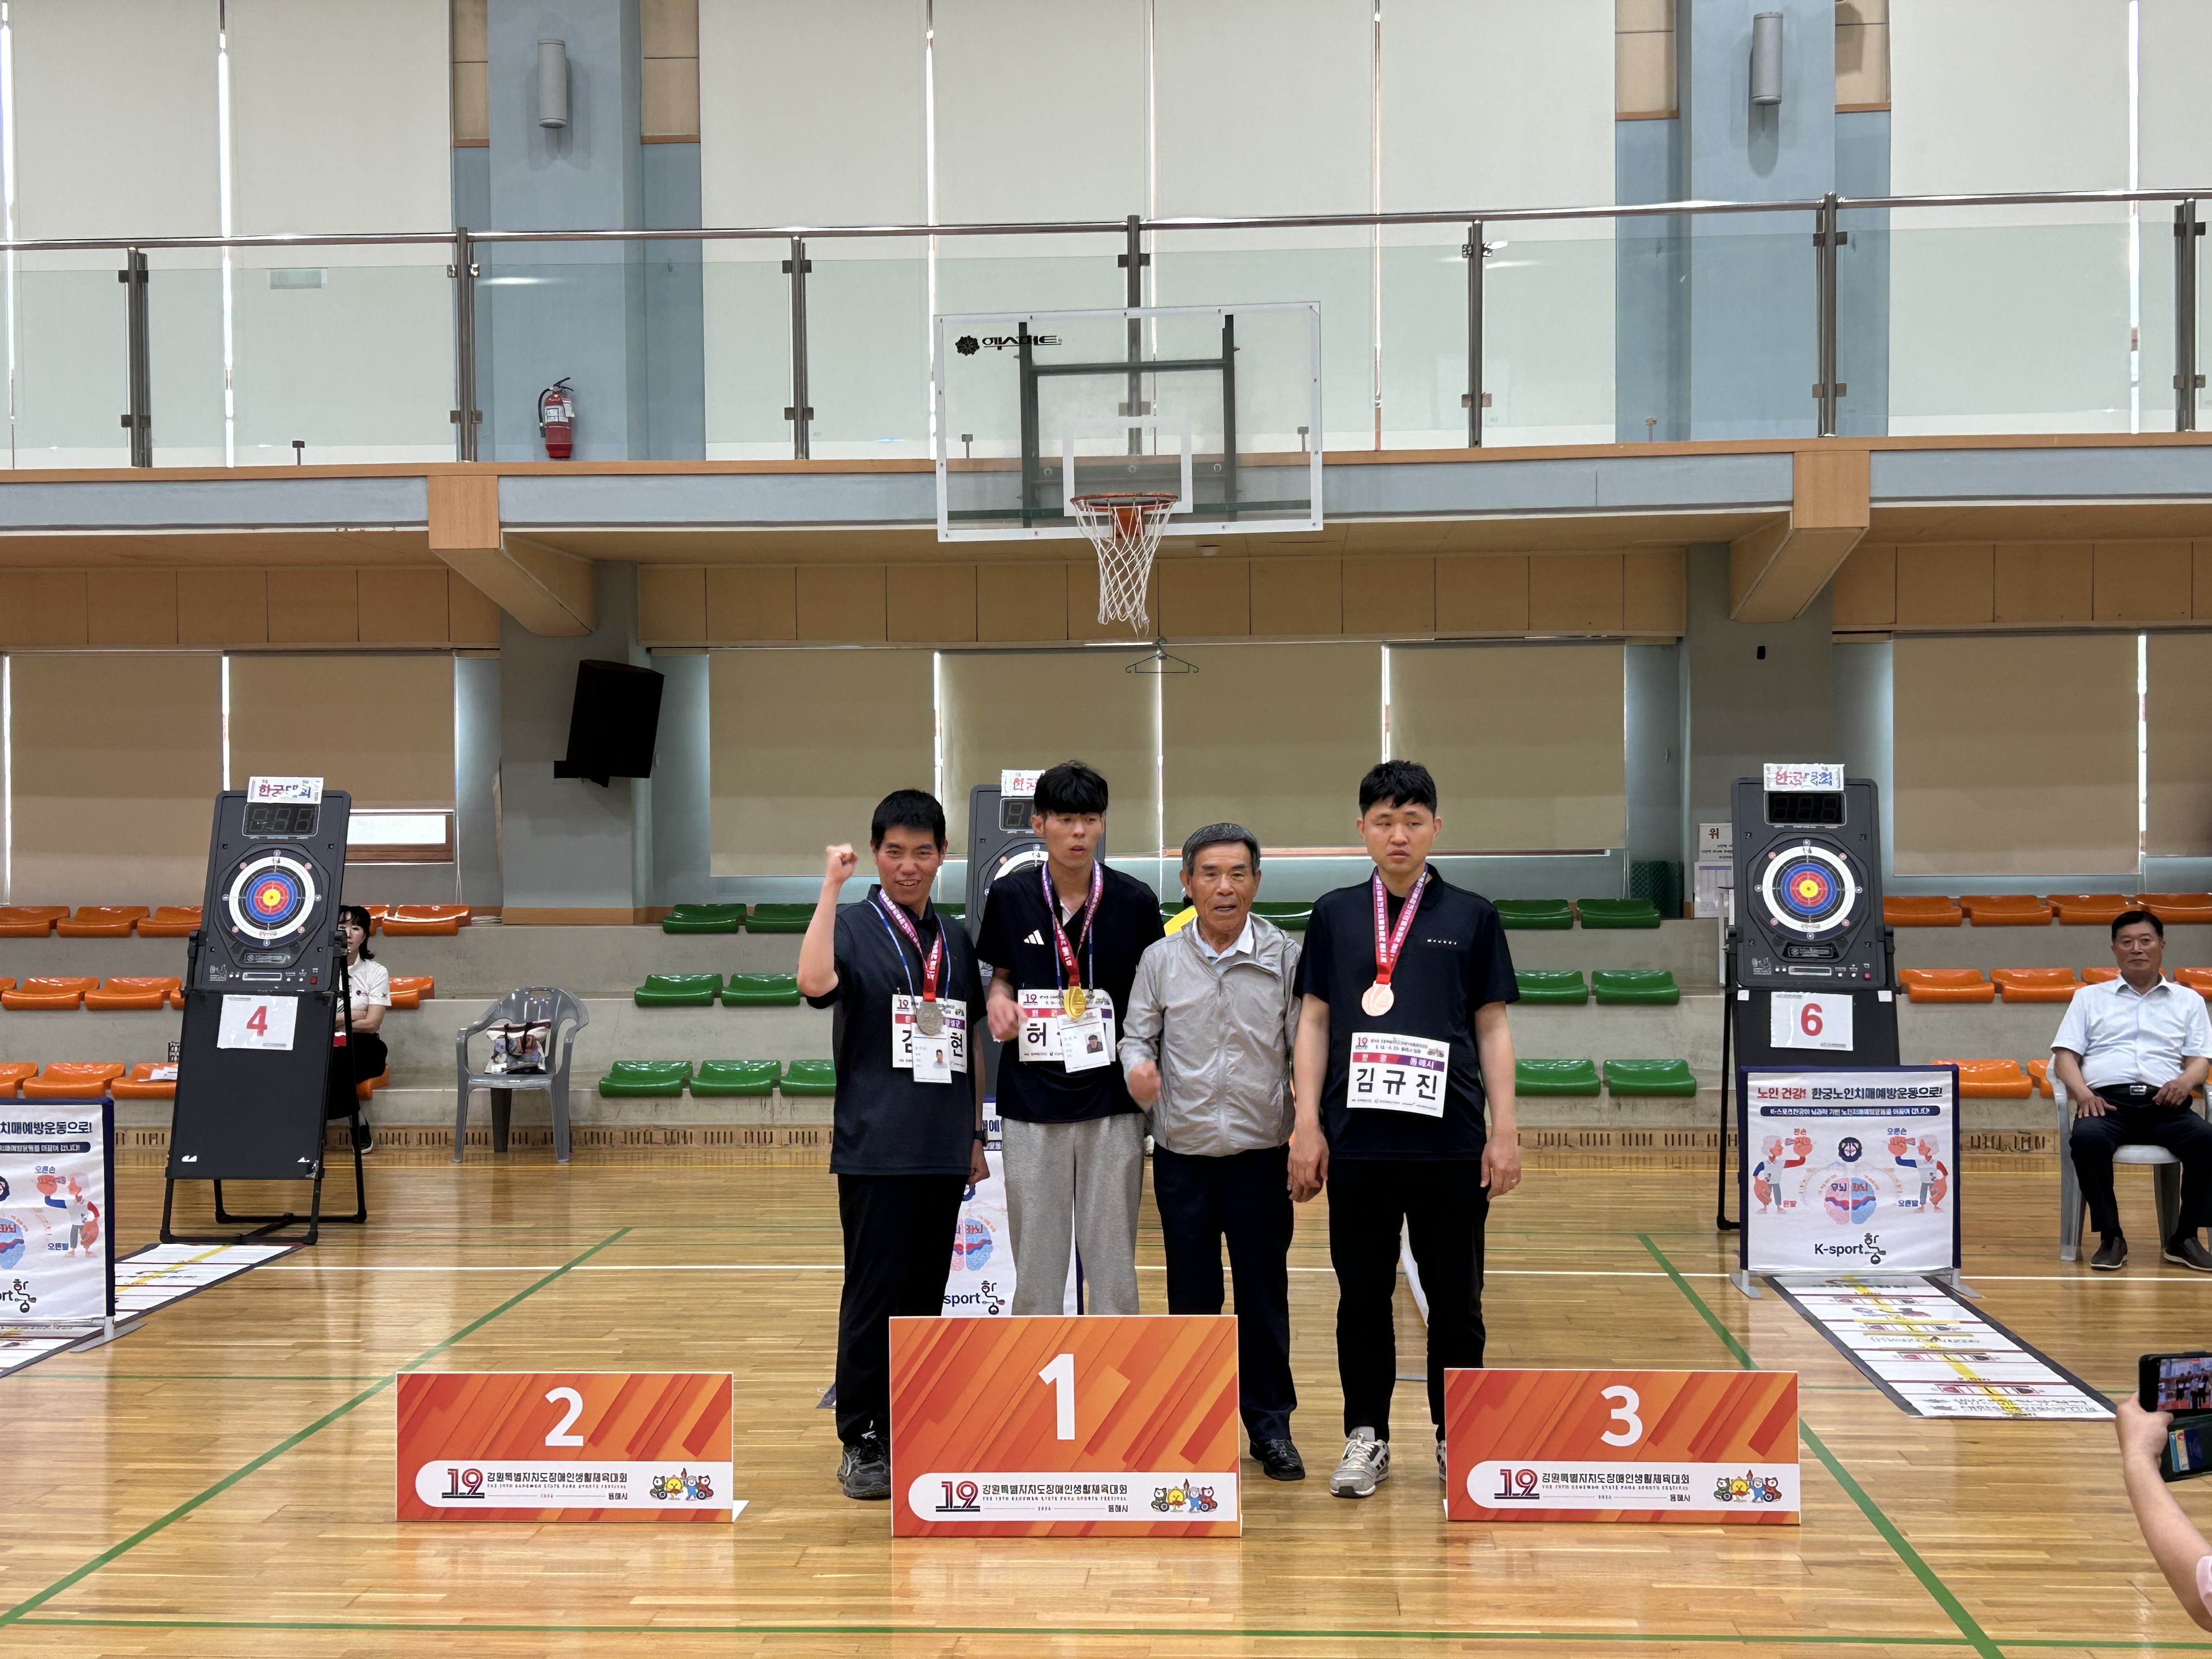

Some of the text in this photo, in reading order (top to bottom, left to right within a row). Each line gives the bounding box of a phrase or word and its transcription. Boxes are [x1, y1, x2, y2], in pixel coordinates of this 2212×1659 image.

[1708, 827, 1719, 839] 위
[246, 1005, 268, 1037] 4
[1801, 1002, 1823, 1037] 6
[1356, 1068, 1437, 1101] 김규진
[1757, 1087, 1779, 1099] 노인
[1782, 1087, 1807, 1099] 건강!
[1814, 1243, 1863, 1257] K-sport
[1038, 1353, 1075, 1440] 1
[545, 1386, 584, 1447] 2
[1600, 1385, 1643, 1447] 3
[442, 1468, 485, 1498] 19
[935, 1481, 980, 1512] 19
[1494, 1469, 1540, 1499] 19
